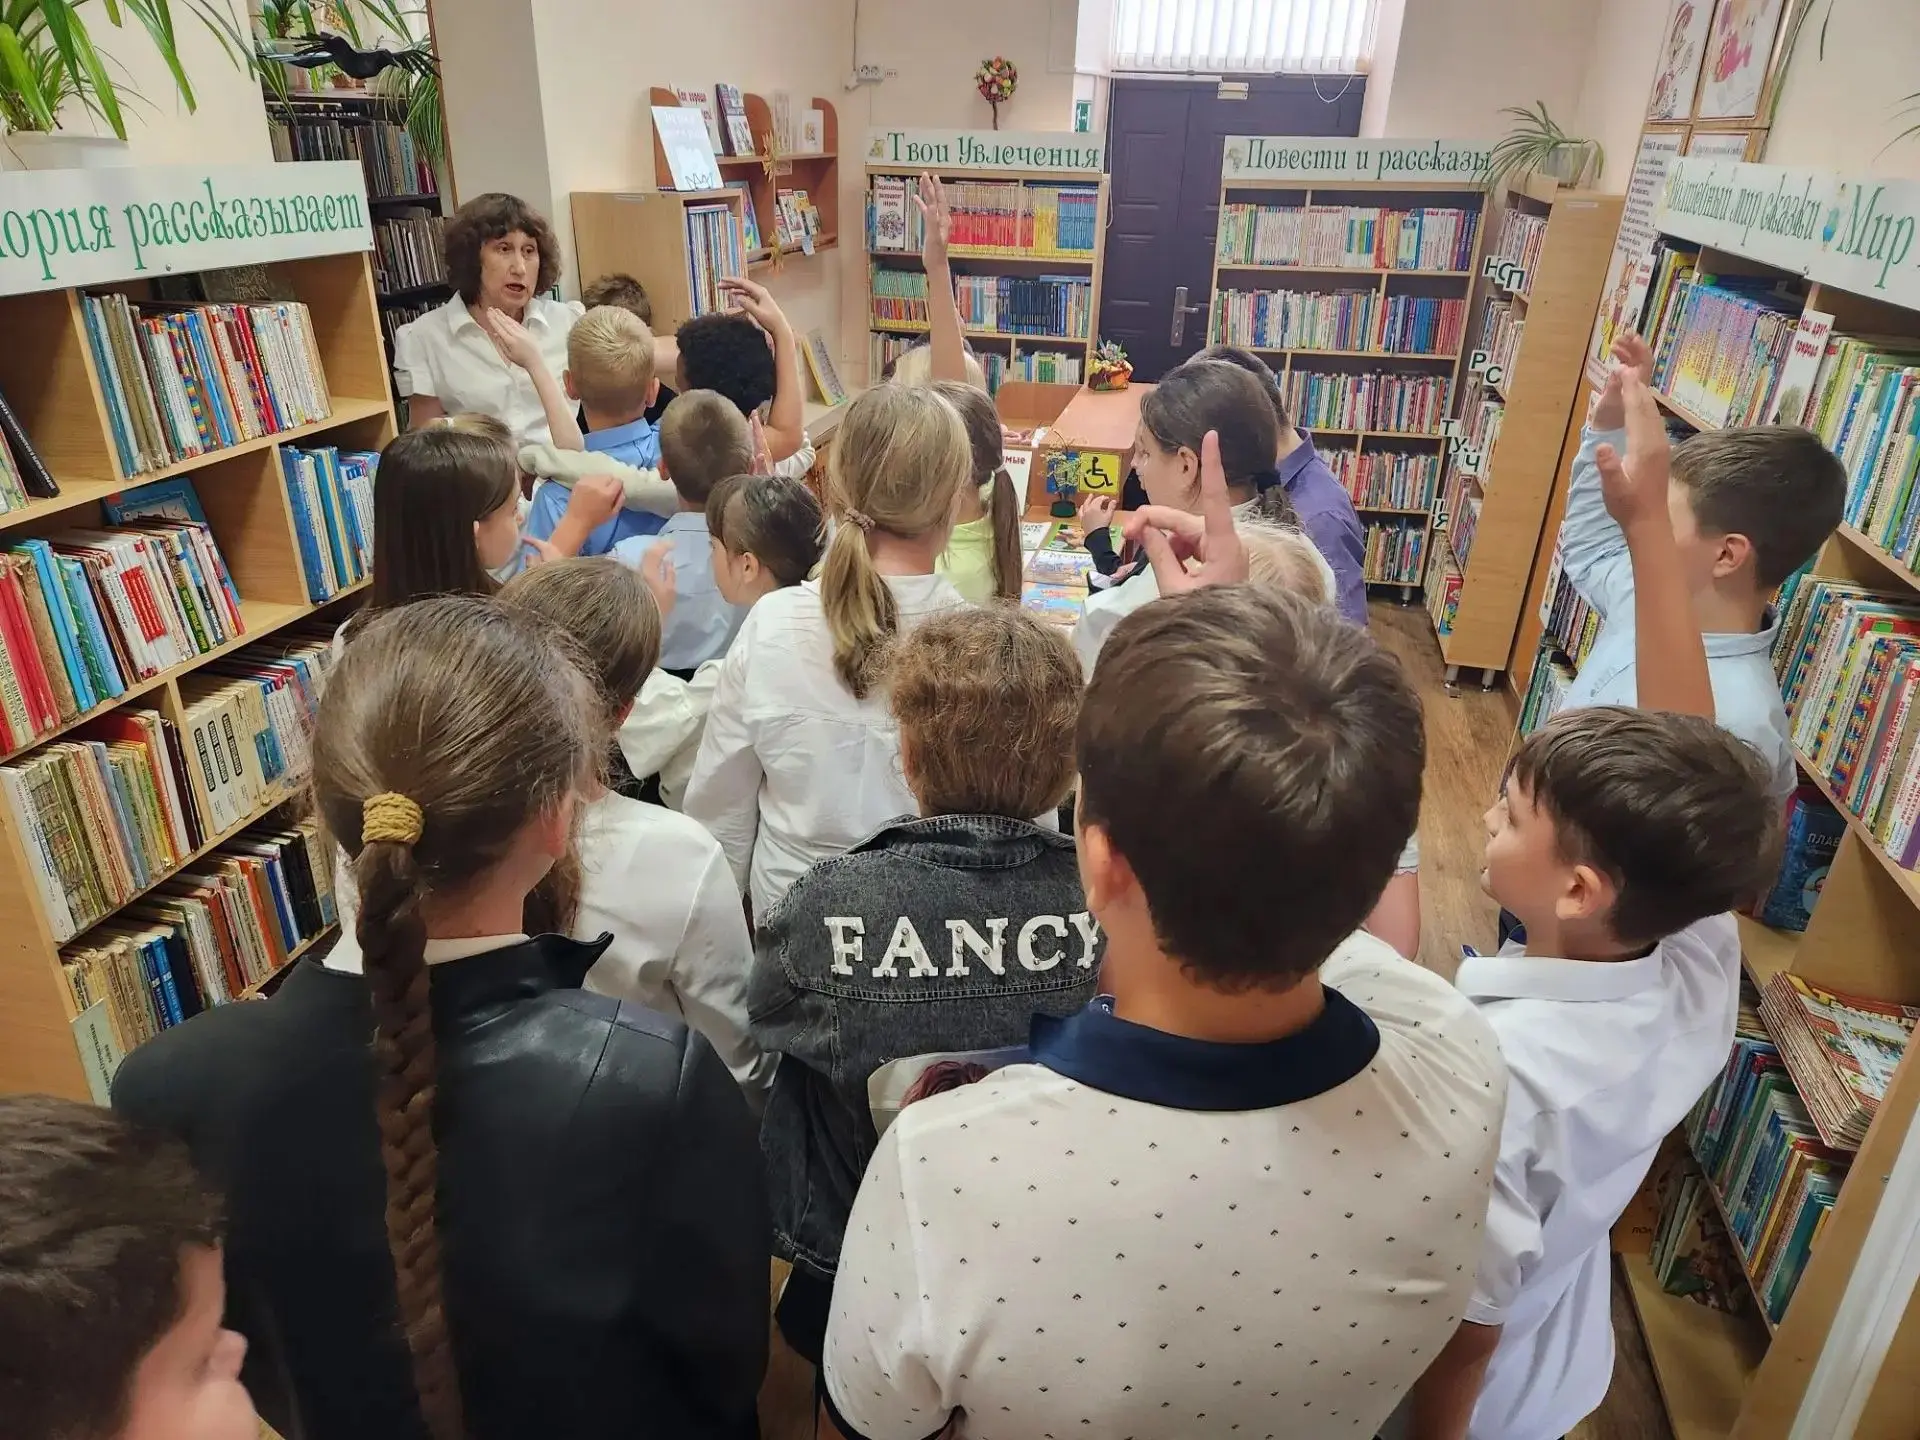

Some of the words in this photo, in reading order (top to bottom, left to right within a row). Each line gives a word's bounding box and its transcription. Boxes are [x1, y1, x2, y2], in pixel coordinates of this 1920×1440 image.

[886, 132, 950, 164] Твои
[957, 135, 1100, 169] Увлечения
[1245, 139, 1347, 171] Повести
[1355, 152, 1368, 171] и
[1378, 139, 1492, 180] рассказы
[1730, 186, 1761, 246] мир
[1761, 172, 1822, 241] сказки
[0, 204, 116, 281] ория
[123, 177, 364, 270] рассказывает
[1835, 183, 1915, 289] Мир
[1506, 269, 1526, 289] П
[1471, 353, 1487, 370] Р
[1485, 366, 1502, 384] С
[1442, 420, 1455, 435] Т
[1452, 437, 1467, 453] У
[1002, 456, 1026, 465] мые
[1465, 454, 1481, 472] Ч
[1435, 512, 1449, 528] Я
[823, 911, 1102, 978] FANCY
